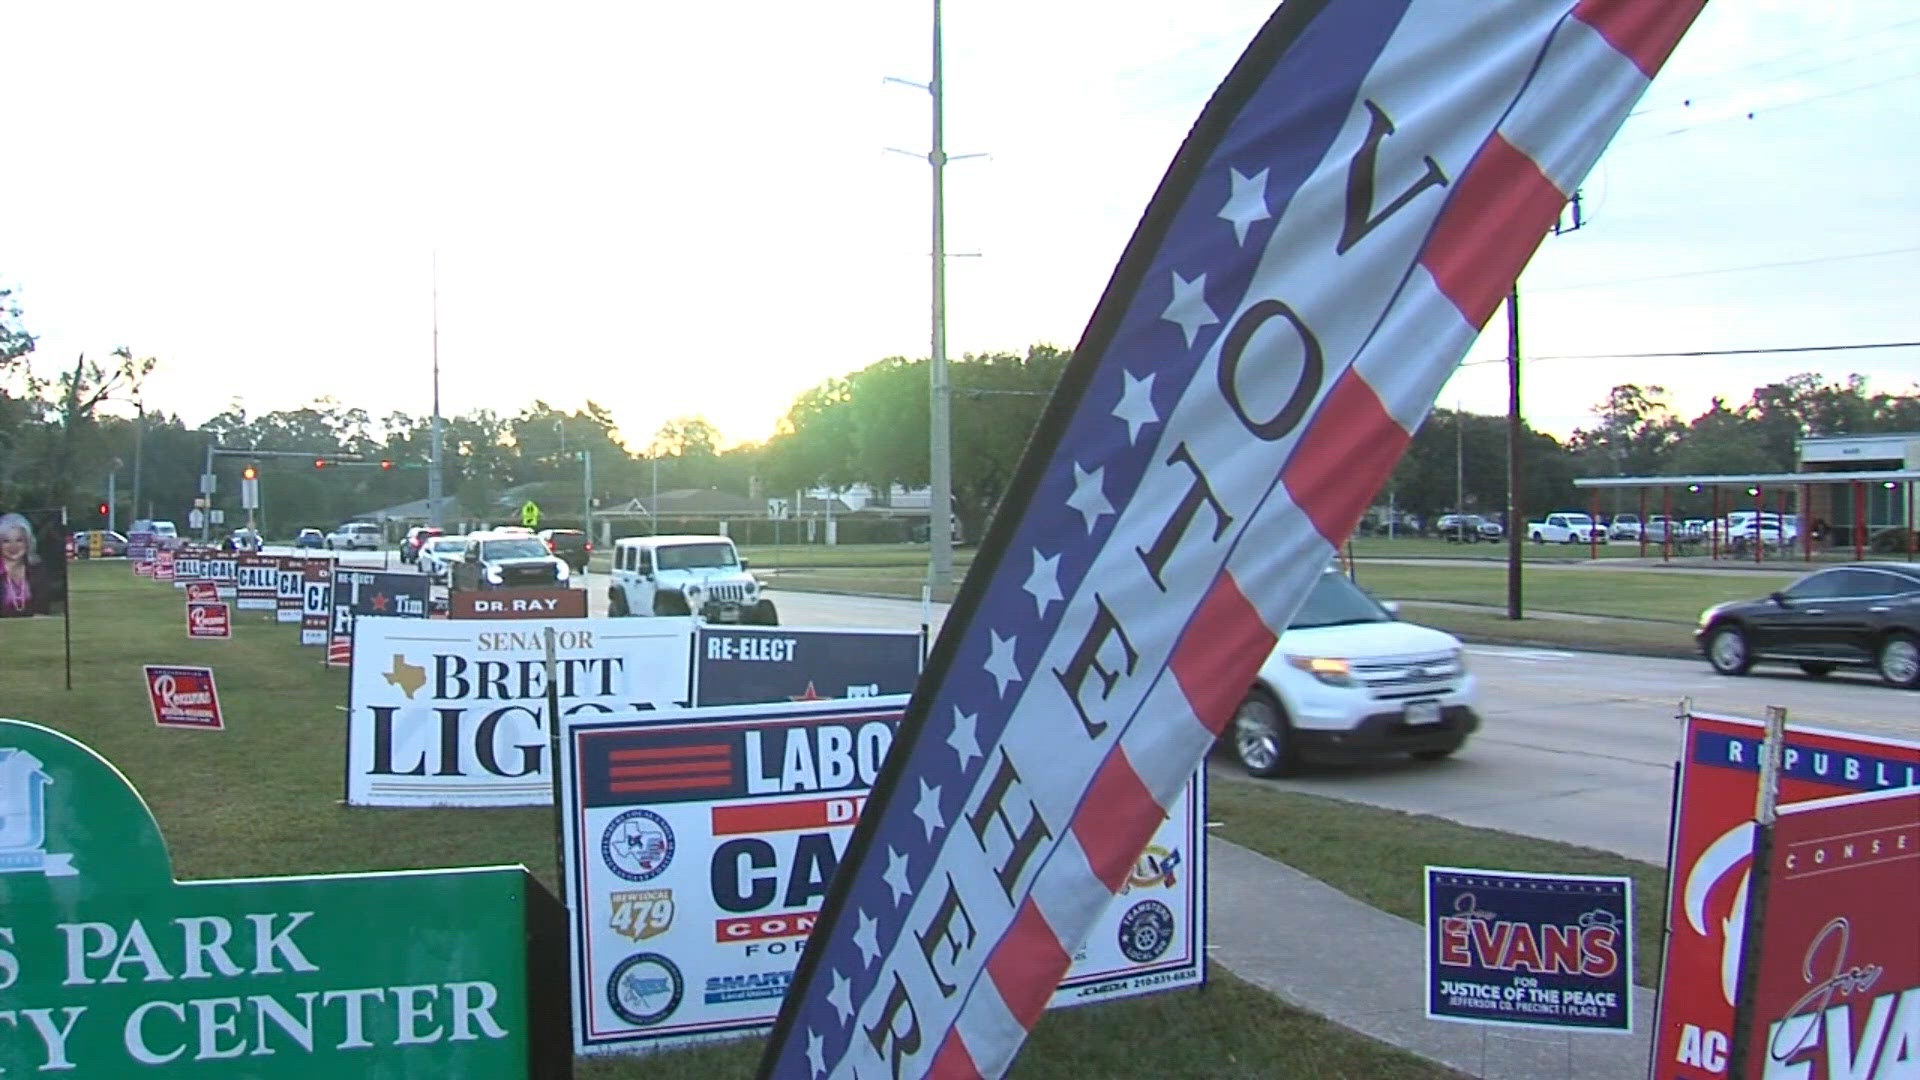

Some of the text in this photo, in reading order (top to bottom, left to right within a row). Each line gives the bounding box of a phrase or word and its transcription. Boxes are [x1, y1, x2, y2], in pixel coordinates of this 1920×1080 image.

[395, 594, 422, 614] Tim
[474, 599, 559, 612] DR. RAY
[853, 100, 1448, 1080] VOTE HER
[477, 631, 594, 652] SENAOR
[707, 637, 797, 662] RE-ELECT
[431, 654, 625, 701] BRETT
[745, 721, 900, 796] LABO
[1785, 835, 1906, 870] CONSE
[611, 900, 673, 938] 479
[57, 911, 320, 986] PARK
[1439, 916, 1618, 978] EVANS
[1439, 981, 1617, 1008] JUSTICE OF THE PEACE
[1513, 977, 1539, 988] FOR
[1771, 917, 1883, 1060] Joe
[123, 981, 509, 1066] CENTER
[1449, 996, 1497, 1010] JEFFERSON
[1516, 1002, 1560, 1015] PRECINCT
[1568, 1005, 1597, 1017] PLACE
